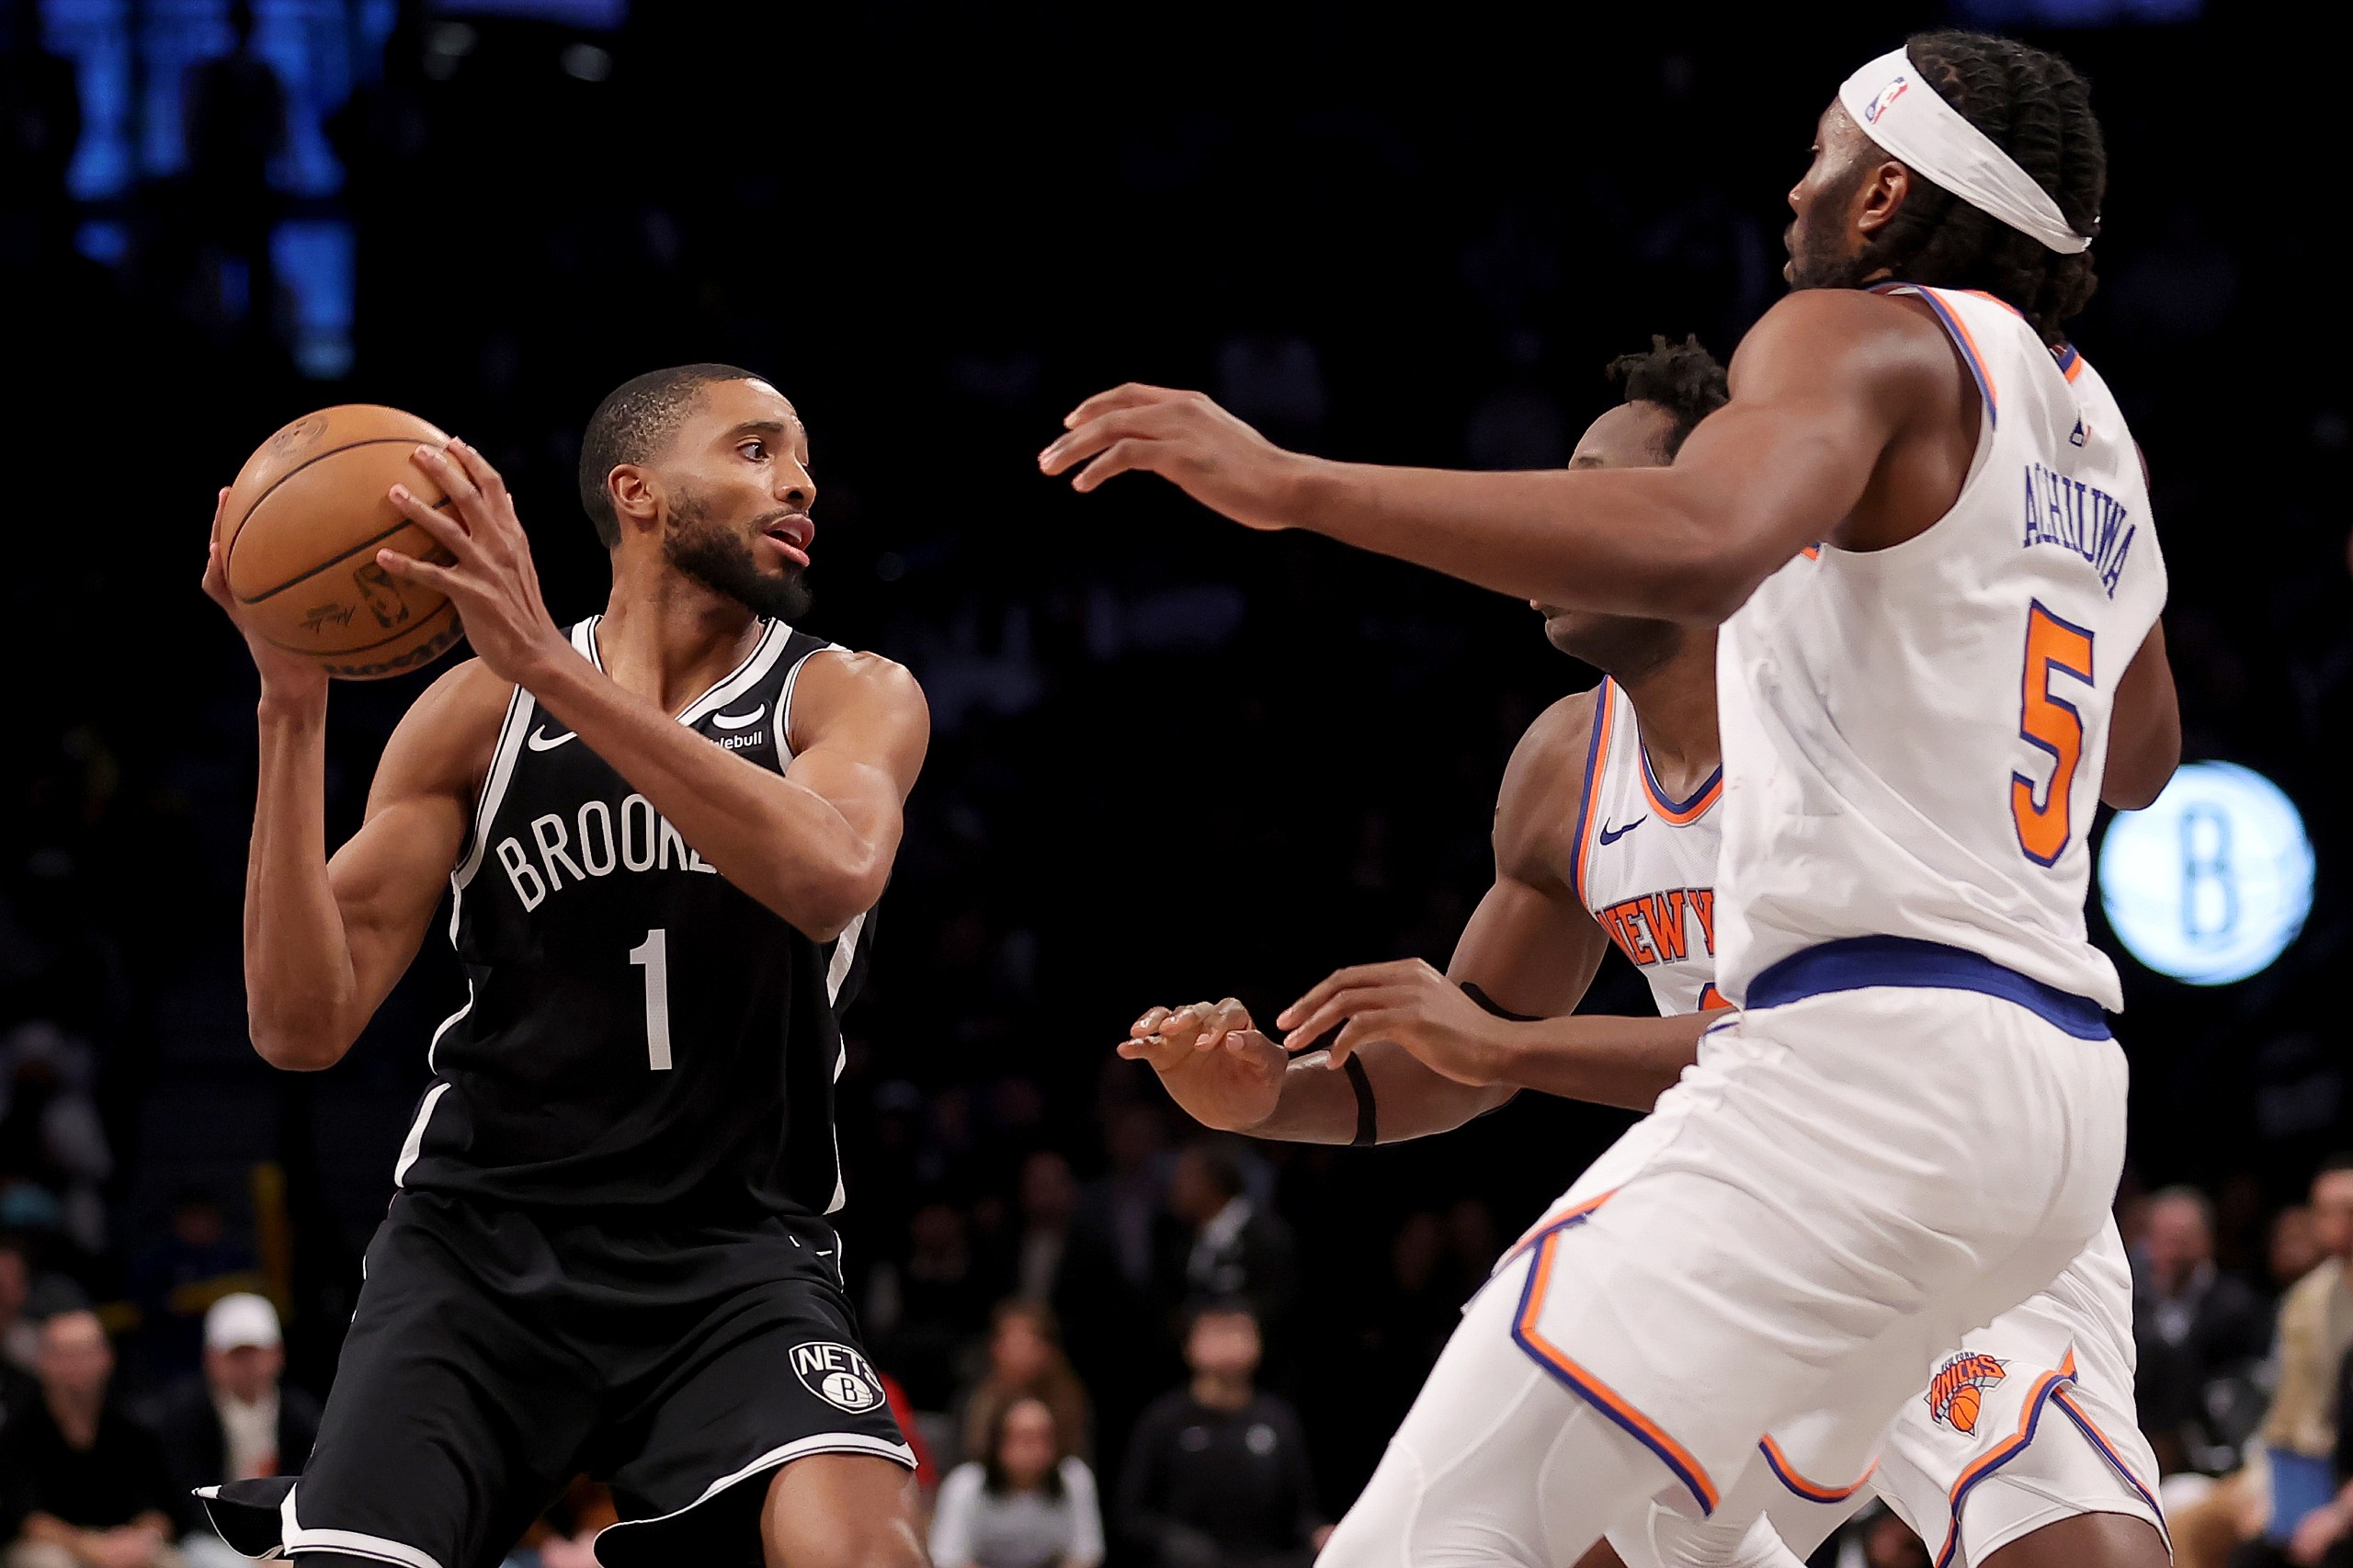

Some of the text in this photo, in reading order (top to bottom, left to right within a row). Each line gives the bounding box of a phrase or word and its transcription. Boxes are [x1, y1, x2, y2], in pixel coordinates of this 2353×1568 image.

[2010, 597, 2095, 868] 5
[496, 793, 718, 913] BROOK
[2178, 801, 2239, 949] B
[630, 929, 672, 1070] 1
[798, 1346, 883, 1392] NETS
[840, 1377, 858, 1402] B
[1931, 1354, 2006, 1419] KNICKS
